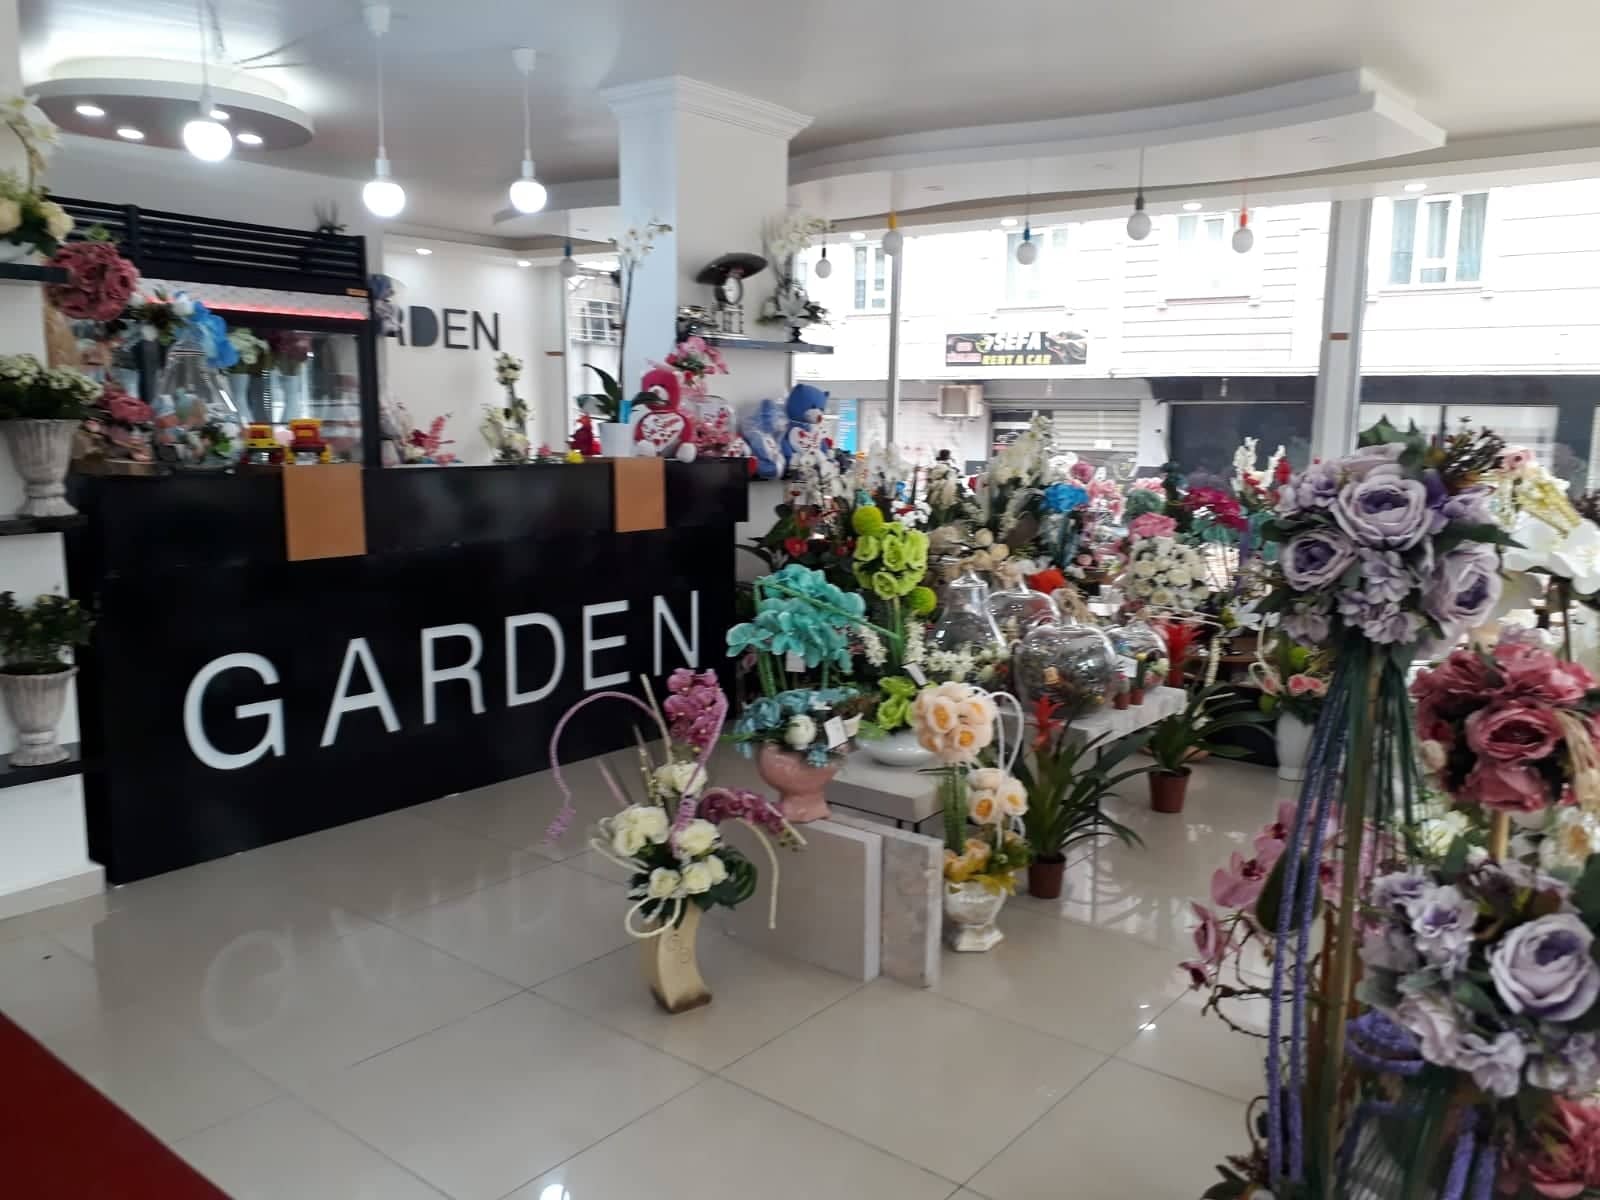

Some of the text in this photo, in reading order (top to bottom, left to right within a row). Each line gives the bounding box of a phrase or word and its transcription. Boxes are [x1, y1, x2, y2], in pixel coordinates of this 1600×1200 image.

[982, 355, 1015, 365] RENT
[1015, 354, 1024, 364] A
[1026, 354, 1052, 364] CAR
[183, 590, 700, 770] GARDEN
